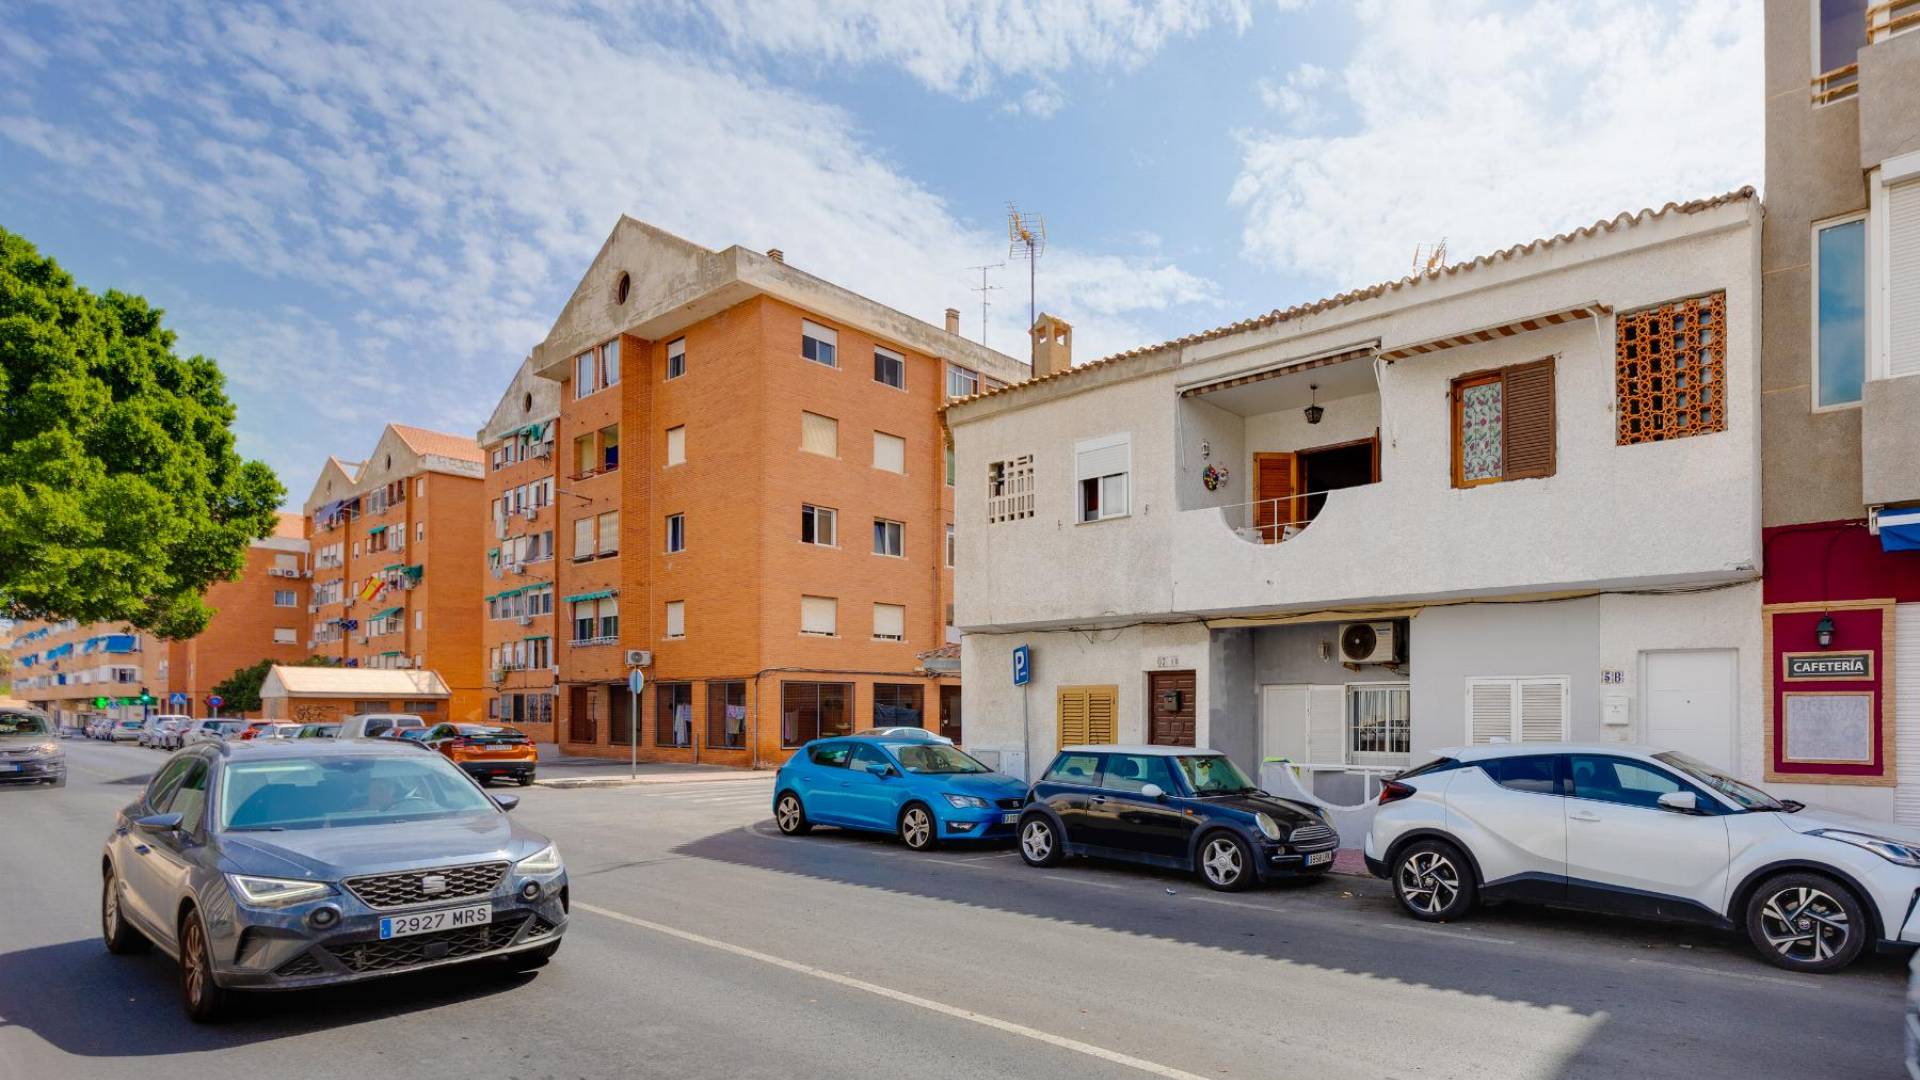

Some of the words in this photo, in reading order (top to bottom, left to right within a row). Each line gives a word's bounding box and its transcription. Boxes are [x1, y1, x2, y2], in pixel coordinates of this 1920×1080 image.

[1015, 651, 1024, 680] P
[1793, 659, 1864, 672] CAFETERÍA
[395, 914, 445, 934] 2927
[452, 908, 487, 926] MRS
